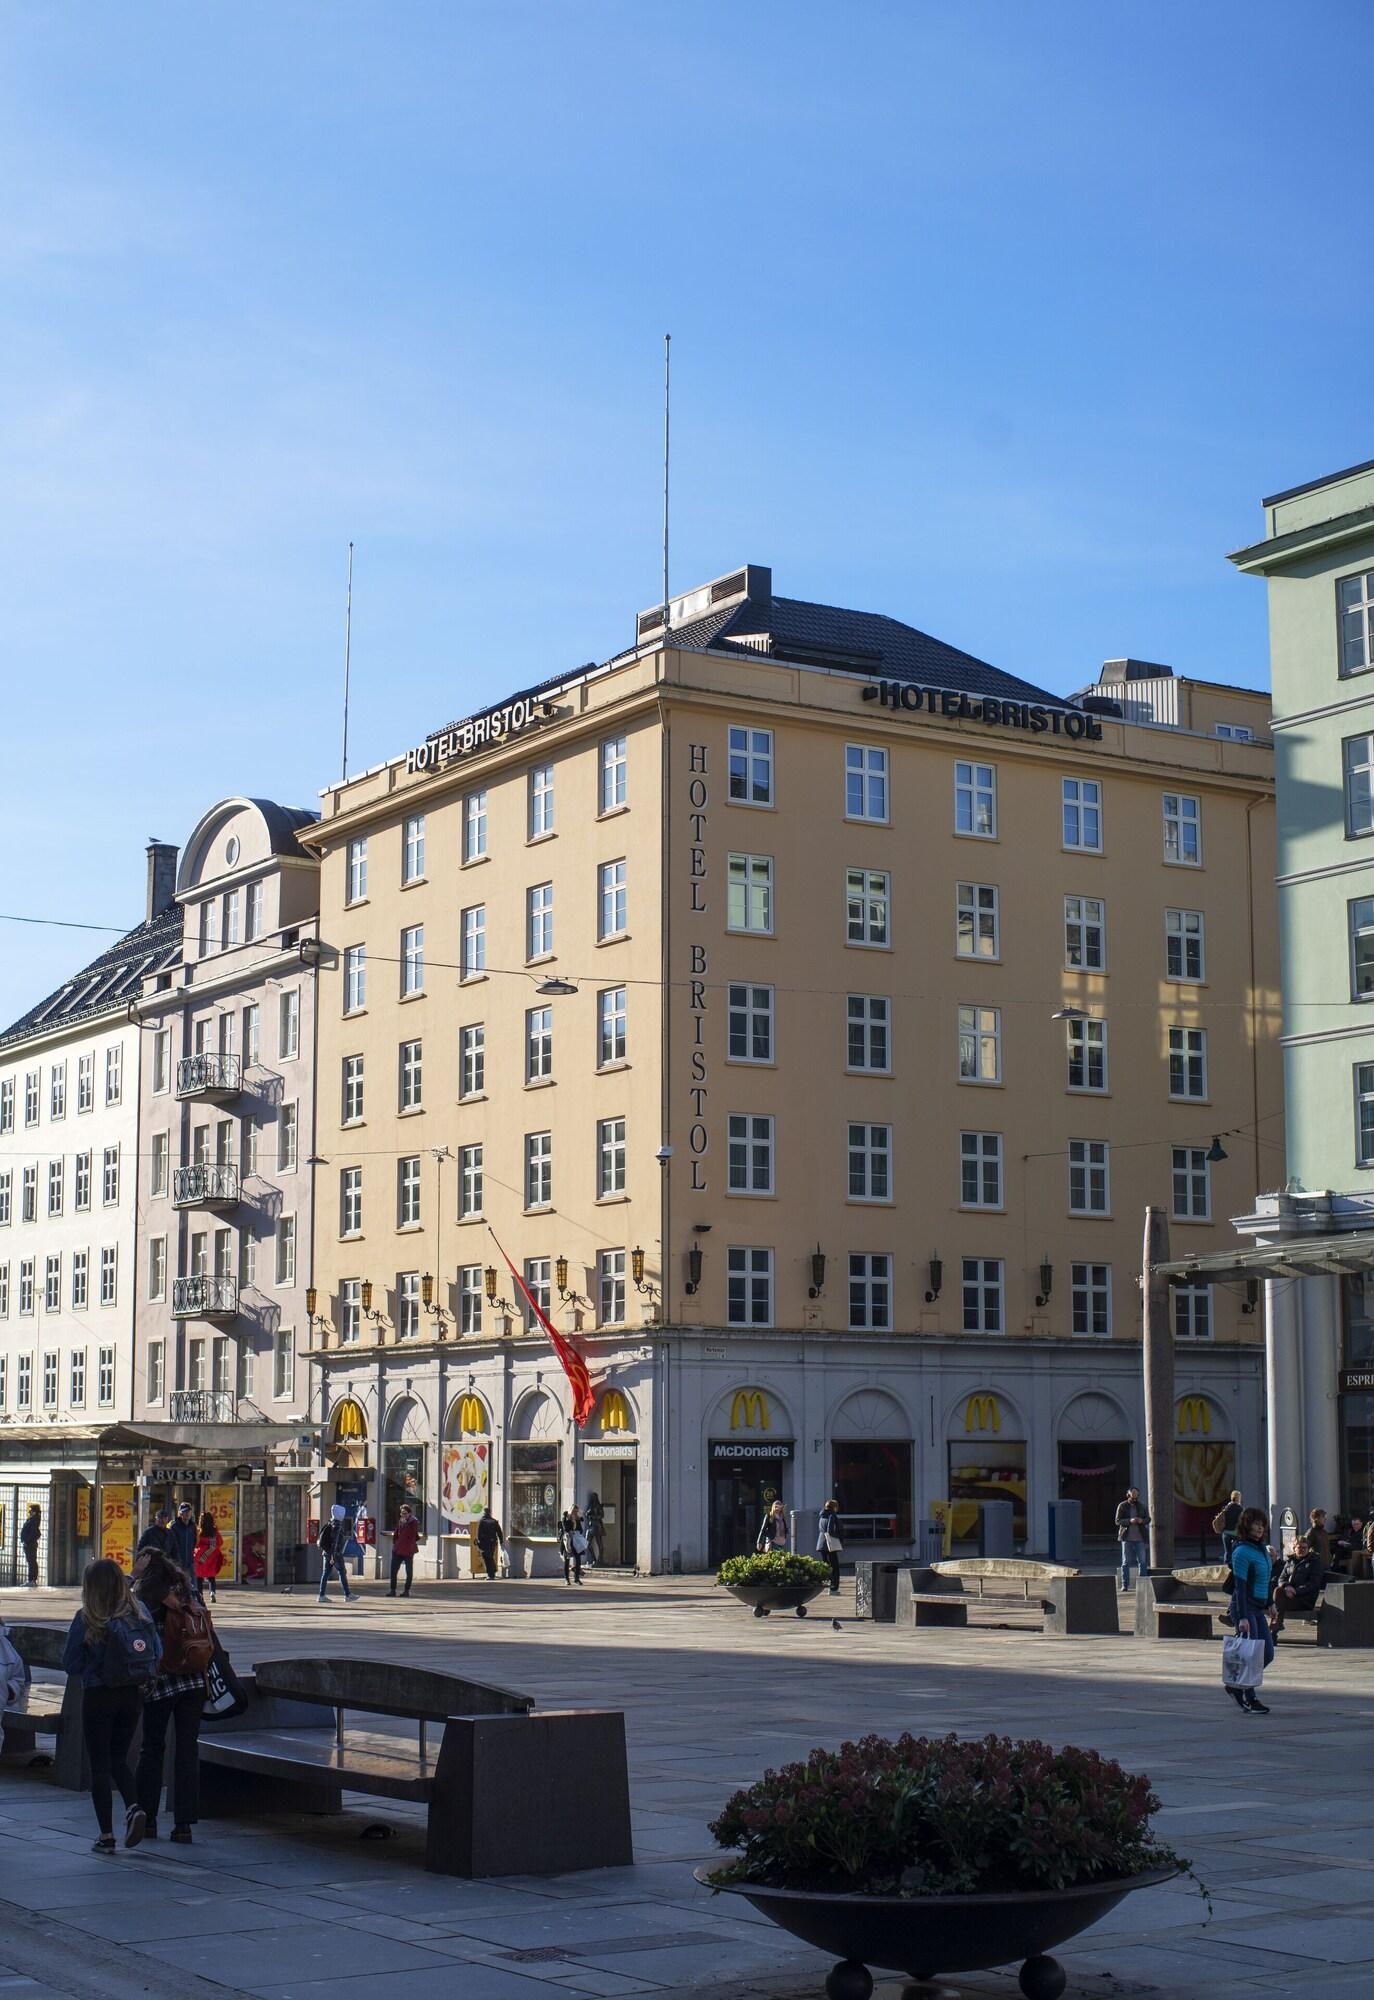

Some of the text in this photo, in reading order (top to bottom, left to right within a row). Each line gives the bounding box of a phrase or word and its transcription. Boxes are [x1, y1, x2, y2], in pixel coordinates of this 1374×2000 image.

[405, 698, 535, 774] HOTEL BRISTOL
[880, 680, 1102, 741] HOTEL BRISTOL
[689, 744, 708, 1190] HOTEL BRISTOL
[587, 1446, 633, 1457] McDonald's
[714, 1445, 789, 1457] McDonald's
